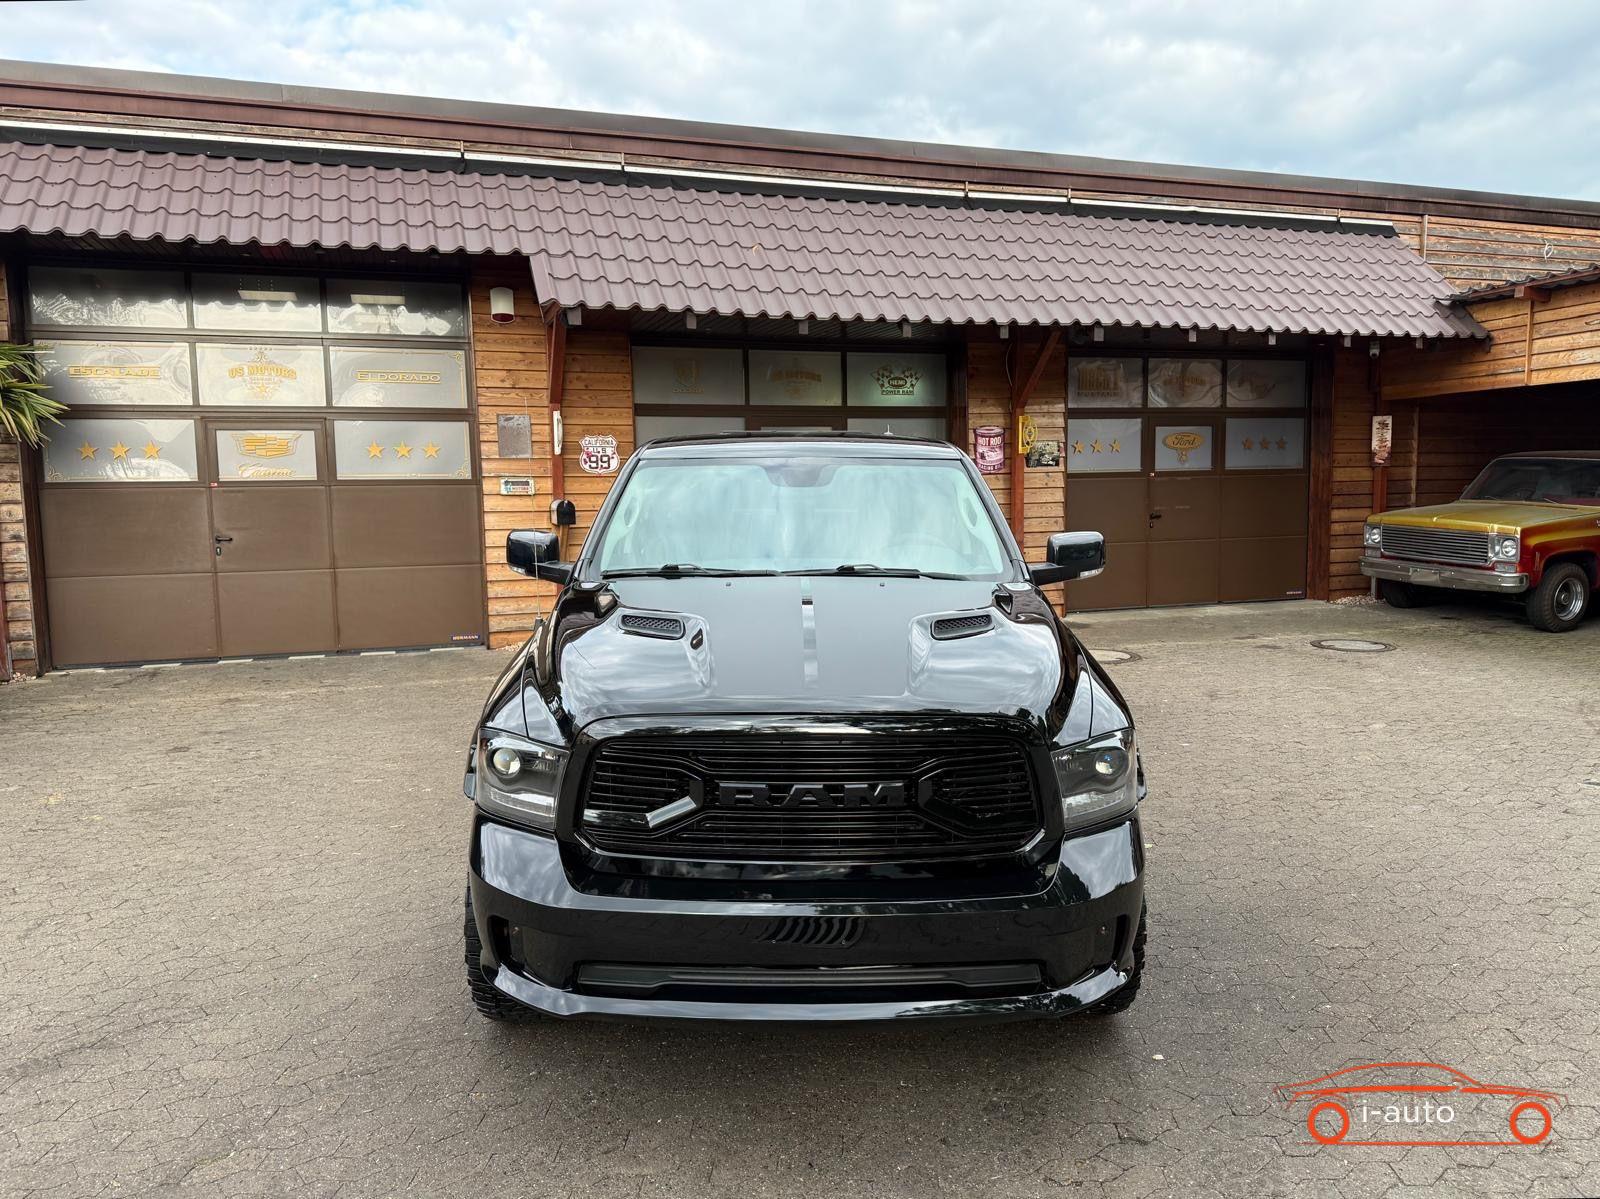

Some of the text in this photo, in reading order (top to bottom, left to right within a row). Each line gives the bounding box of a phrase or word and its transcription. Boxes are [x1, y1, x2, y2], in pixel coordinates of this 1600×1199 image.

[69, 367, 160, 377] ESCALADE
[228, 367, 244, 378] US
[248, 365, 297, 379] MOTORS
[357, 371, 440, 382] ELDORADO
[889, 379, 906, 387] HEMI
[584, 438, 614, 446] CALIFORNIA
[977, 436, 1002, 446] HOT ROD
[1171, 435, 1196, 447] Ford
[589, 455, 610, 469] 99
[719, 782, 905, 807] RAM
